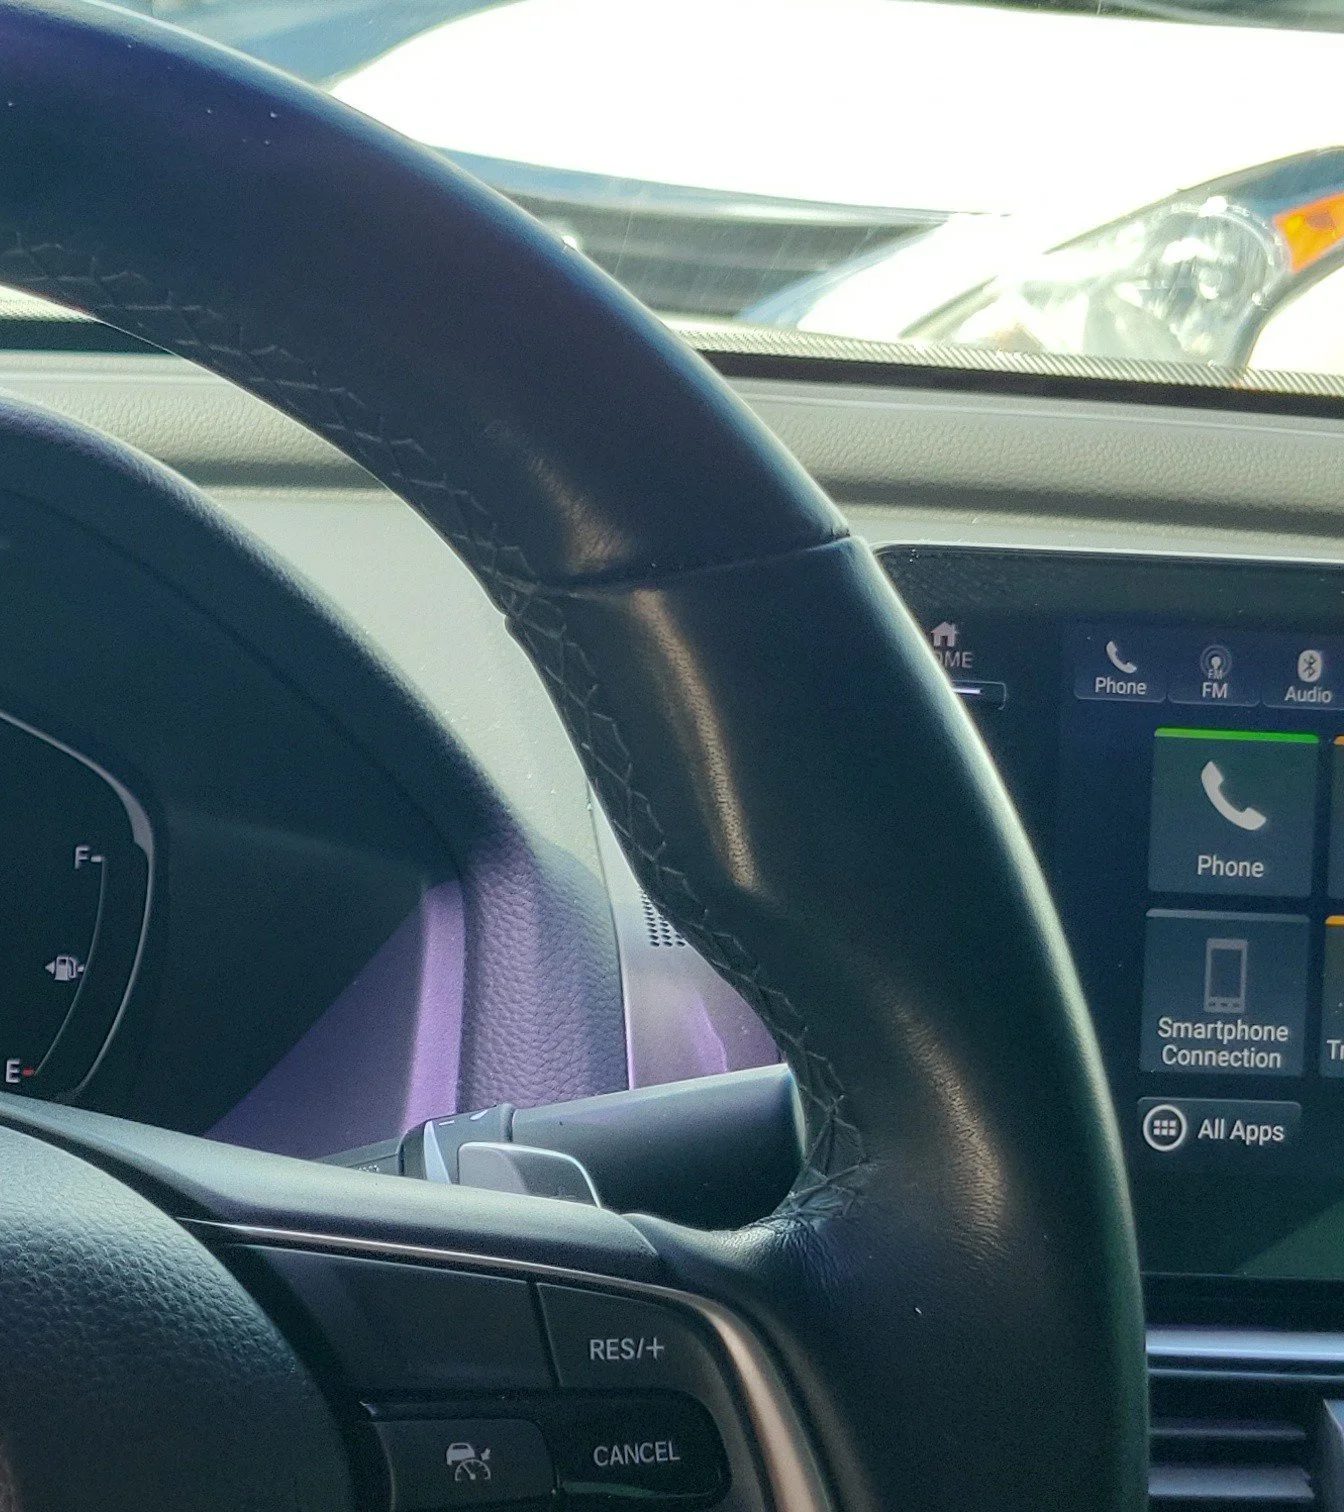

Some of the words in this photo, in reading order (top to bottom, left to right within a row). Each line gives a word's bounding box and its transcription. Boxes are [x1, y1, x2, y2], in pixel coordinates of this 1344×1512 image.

[932, 651, 973, 669] OME
[1094, 677, 1147, 695] Phone
[1202, 682, 1229, 699] FM
[1284, 686, 1333, 704] Audio
[74, 846, 91, 870] F
[1196, 855, 1265, 879] Phone
[1157, 1017, 1289, 1044] Smartphone
[1161, 1043, 1281, 1068] Connection
[5, 1060, 22, 1084] E
[1197, 1118, 1226, 1141] All
[1230, 1119, 1285, 1145] Apps
[589, 1337, 665, 1361] RES/+
[593, 1441, 680, 1467] CANCEL
